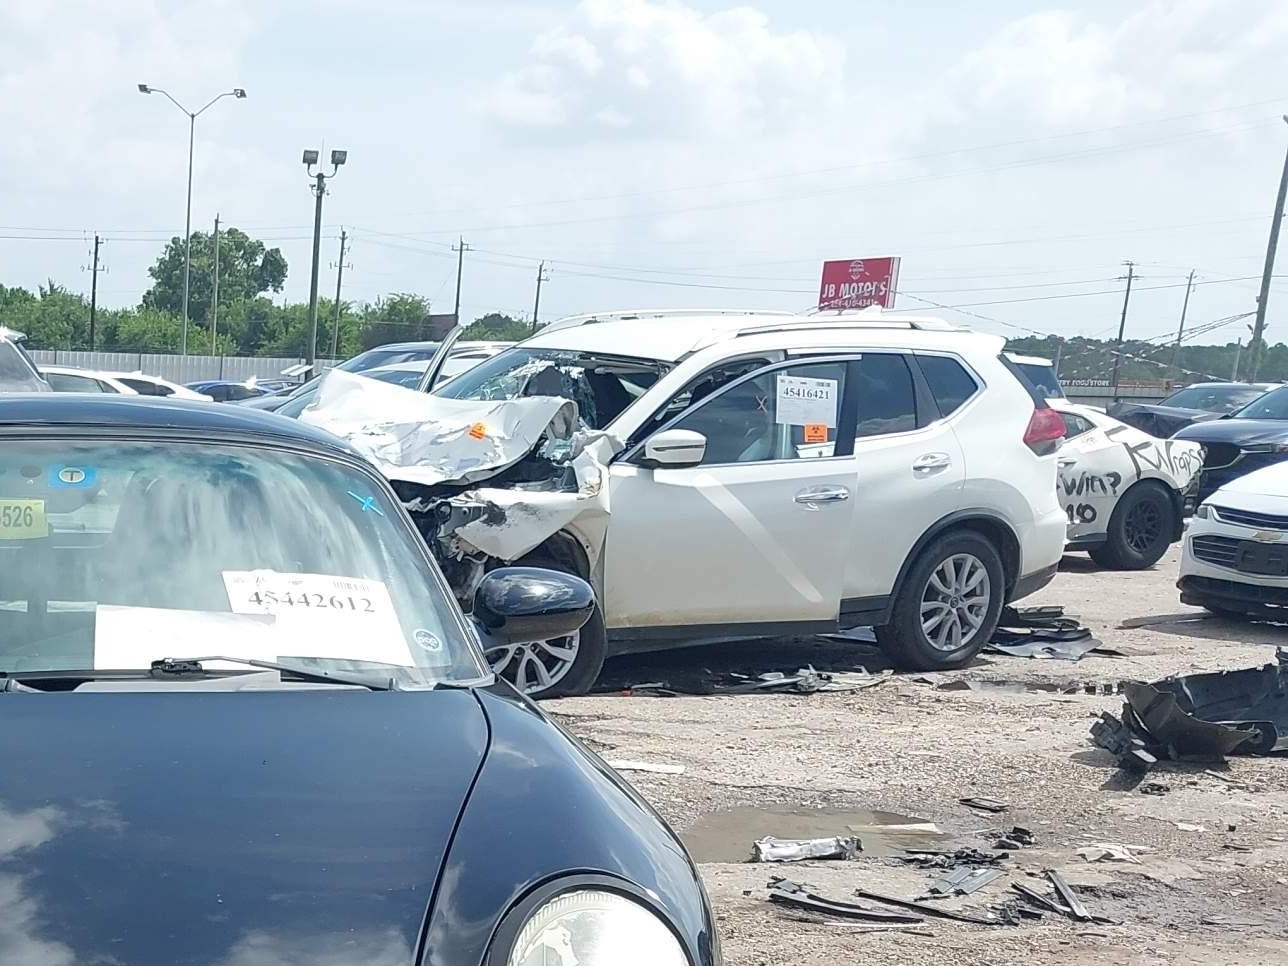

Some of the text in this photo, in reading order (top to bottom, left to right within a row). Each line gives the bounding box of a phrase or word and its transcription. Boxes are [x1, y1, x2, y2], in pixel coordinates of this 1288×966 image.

[822, 284, 835, 299] JB
[783, 387, 830, 399] 45416421
[248, 589, 377, 614] 45442612
